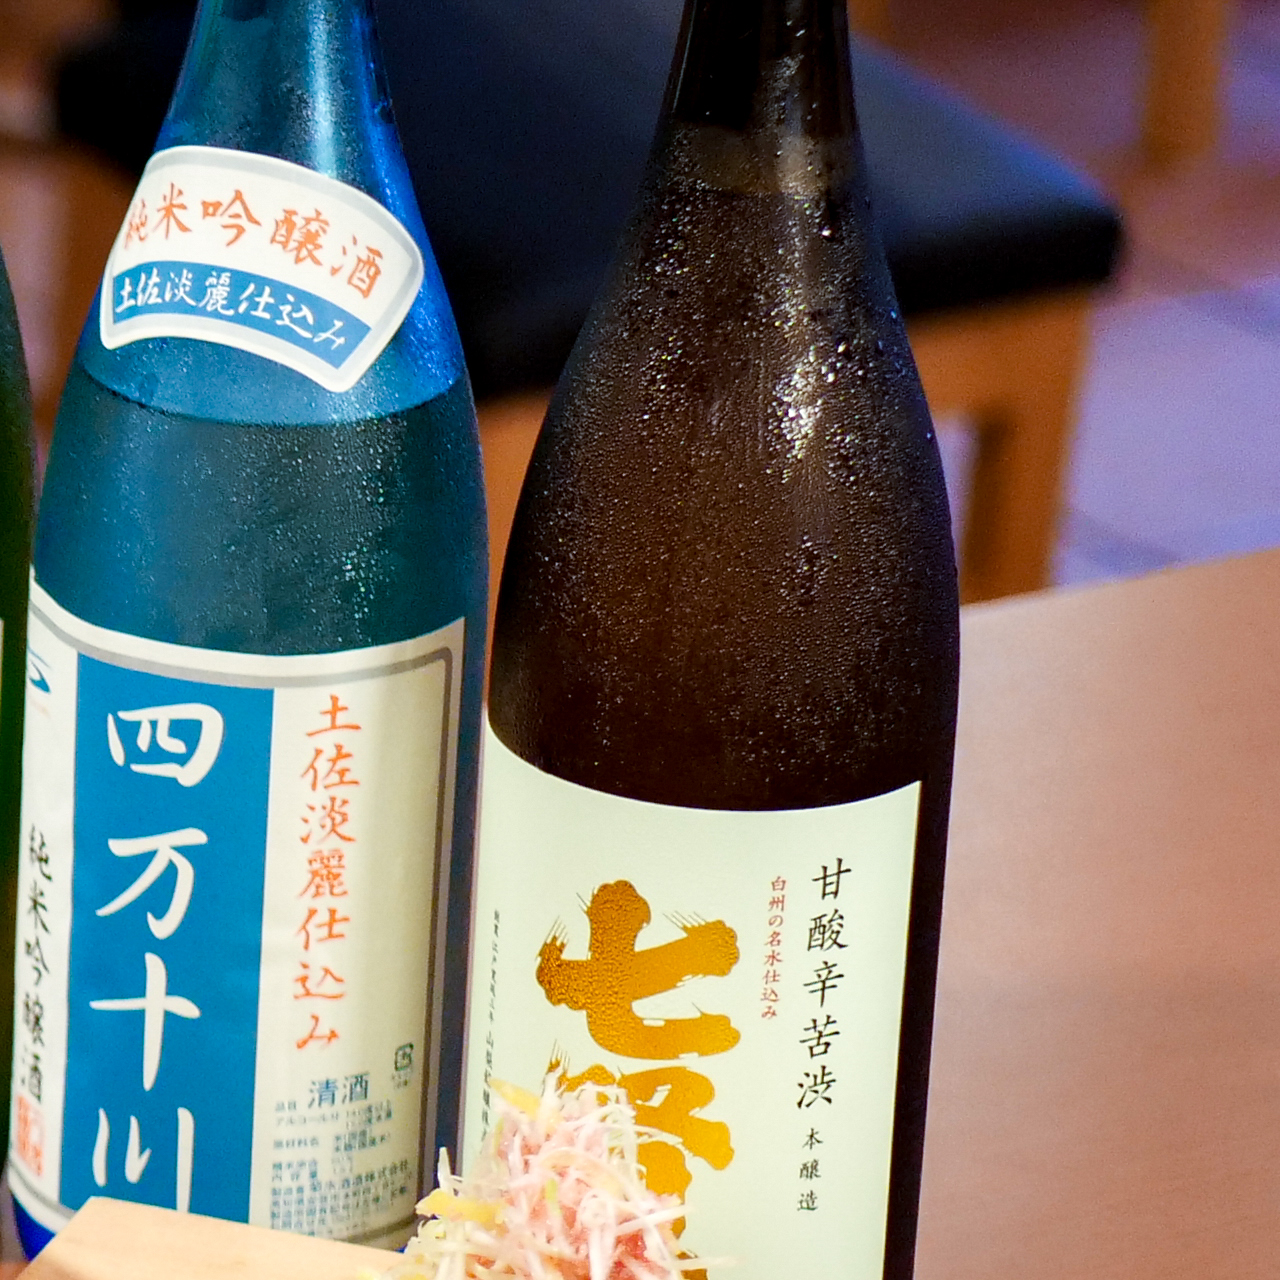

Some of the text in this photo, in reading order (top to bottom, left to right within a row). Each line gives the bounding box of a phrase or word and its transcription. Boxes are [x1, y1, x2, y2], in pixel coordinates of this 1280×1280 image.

[124, 182, 384, 299] 純米吟醸酒
[115, 267, 347, 351] 土佐淡麗仕込み
[292, 693, 363, 1051] 土佐淡麗仕込み
[88, 701, 226, 1215] 四万十川
[760, 875, 788, 1020] 白州の名水仕込み
[796, 857, 852, 1111] 甘酸辛苦渋
[308, 1072, 371, 1109] 清酒
[797, 1126, 824, 1212] 本醸造
